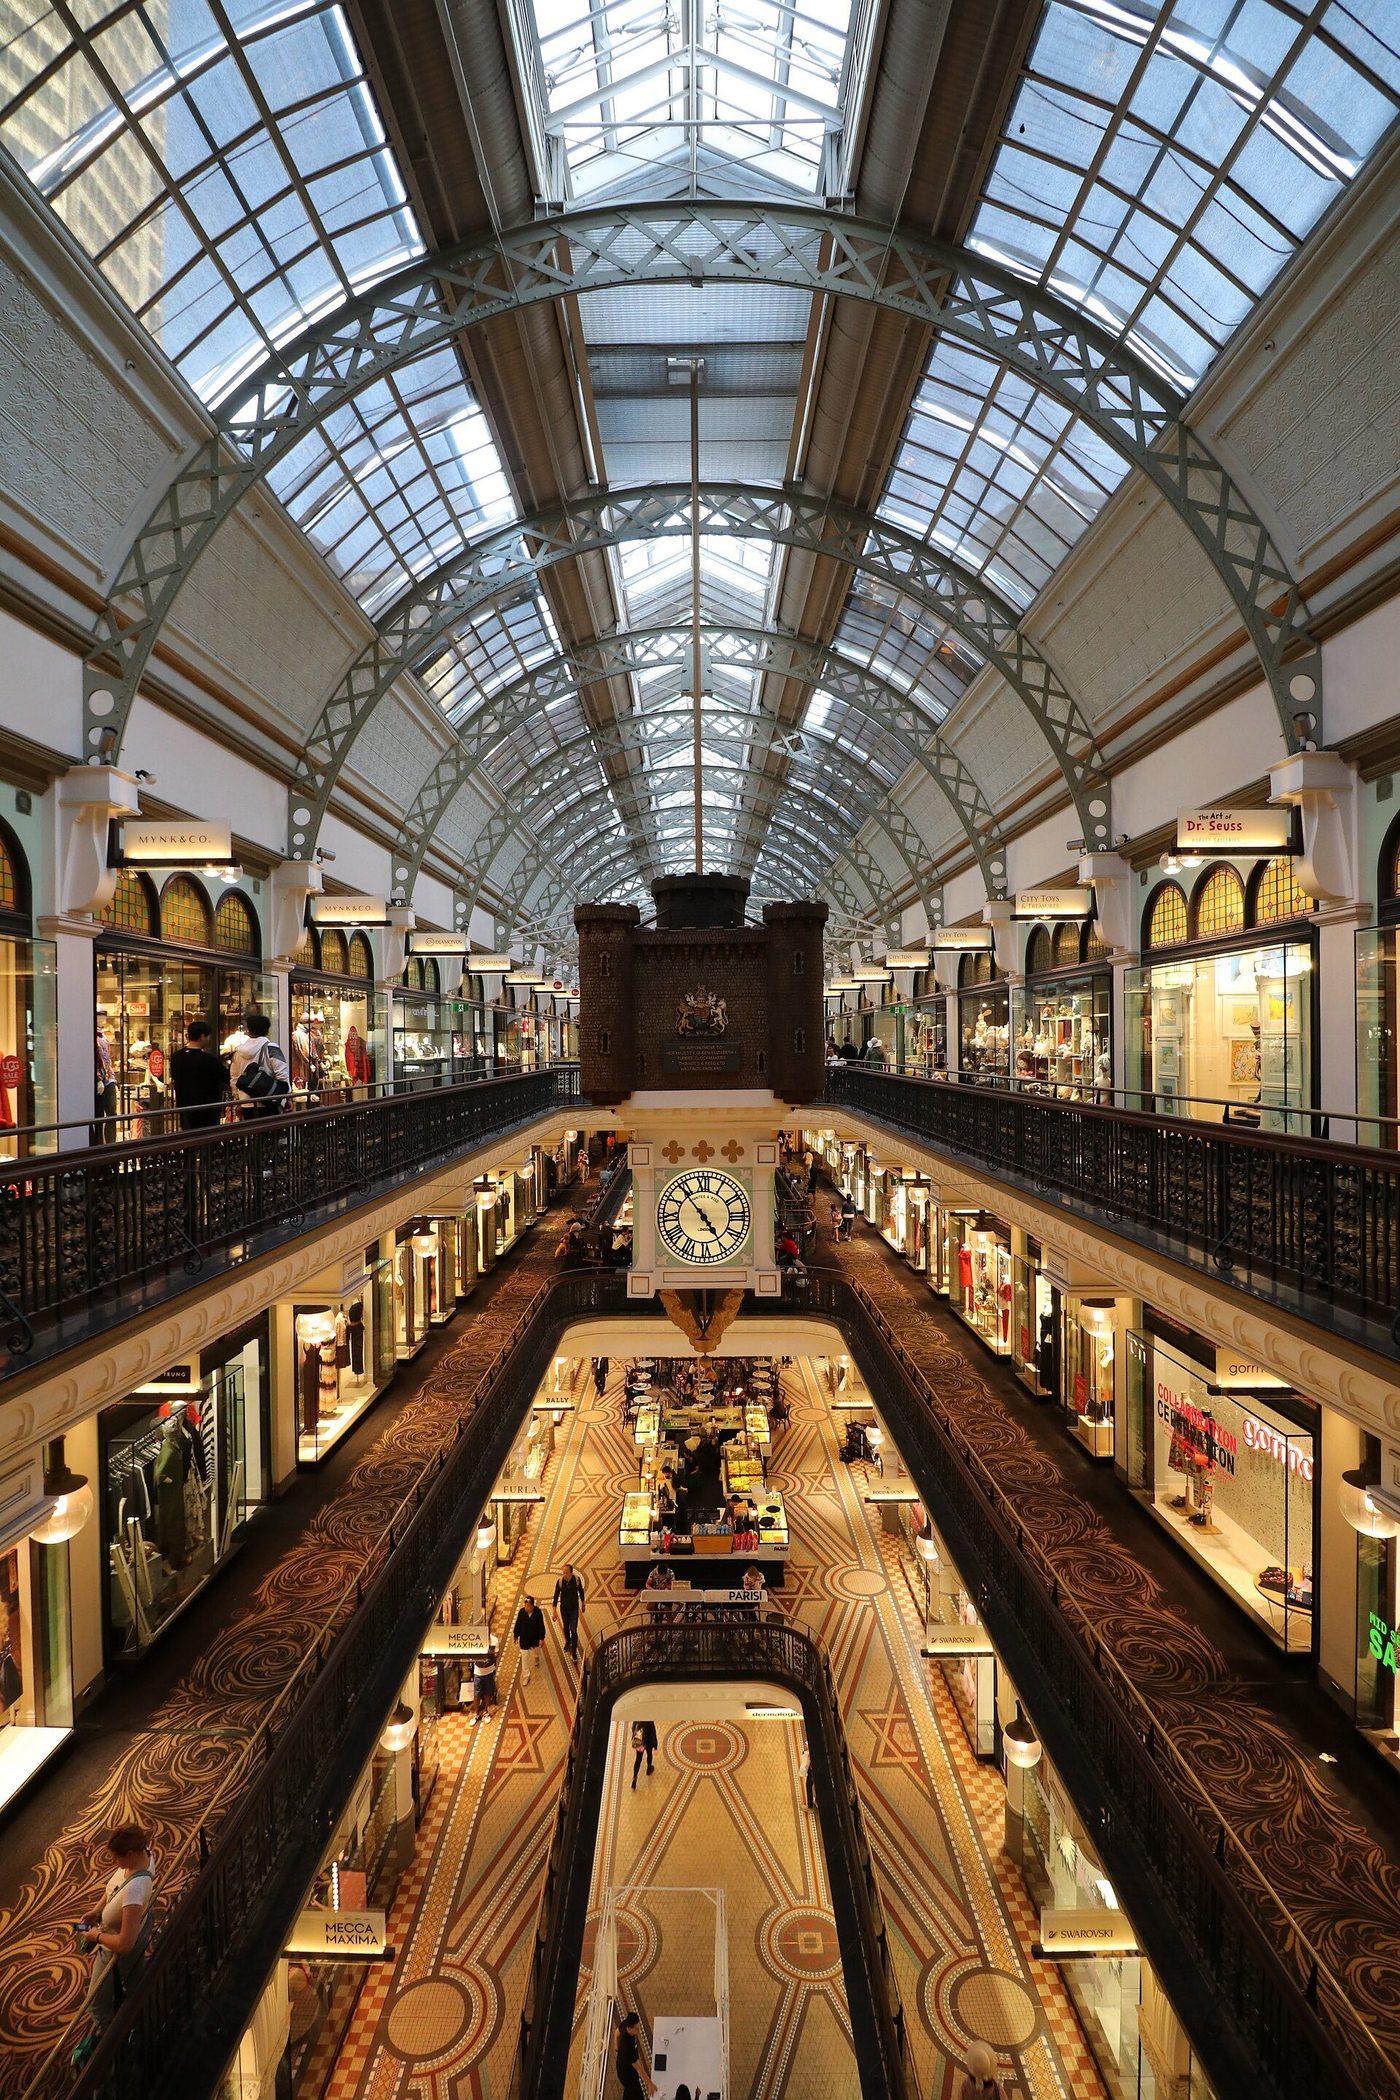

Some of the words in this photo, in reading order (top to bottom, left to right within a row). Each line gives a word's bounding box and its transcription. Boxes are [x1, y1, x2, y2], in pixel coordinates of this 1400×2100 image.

[1210, 812, 1223, 820] Art
[1186, 820, 1205, 831] Dr.
[1209, 820, 1243, 831] Seuss
[1040, 894, 1060, 903] TOYS
[1157, 1383, 1237, 1455] COLLABORATION
[503, 1485, 538, 1493] FURLA
[729, 1591, 762, 1601] PARISI
[1370, 1611, 1387, 1635] MID
[448, 1633, 482, 1641] MECCA
[325, 1922, 374, 1934] MECCA
[1060, 1929, 1113, 1939] SWAROVSKI
[325, 1934, 379, 1945] MAXIMA
